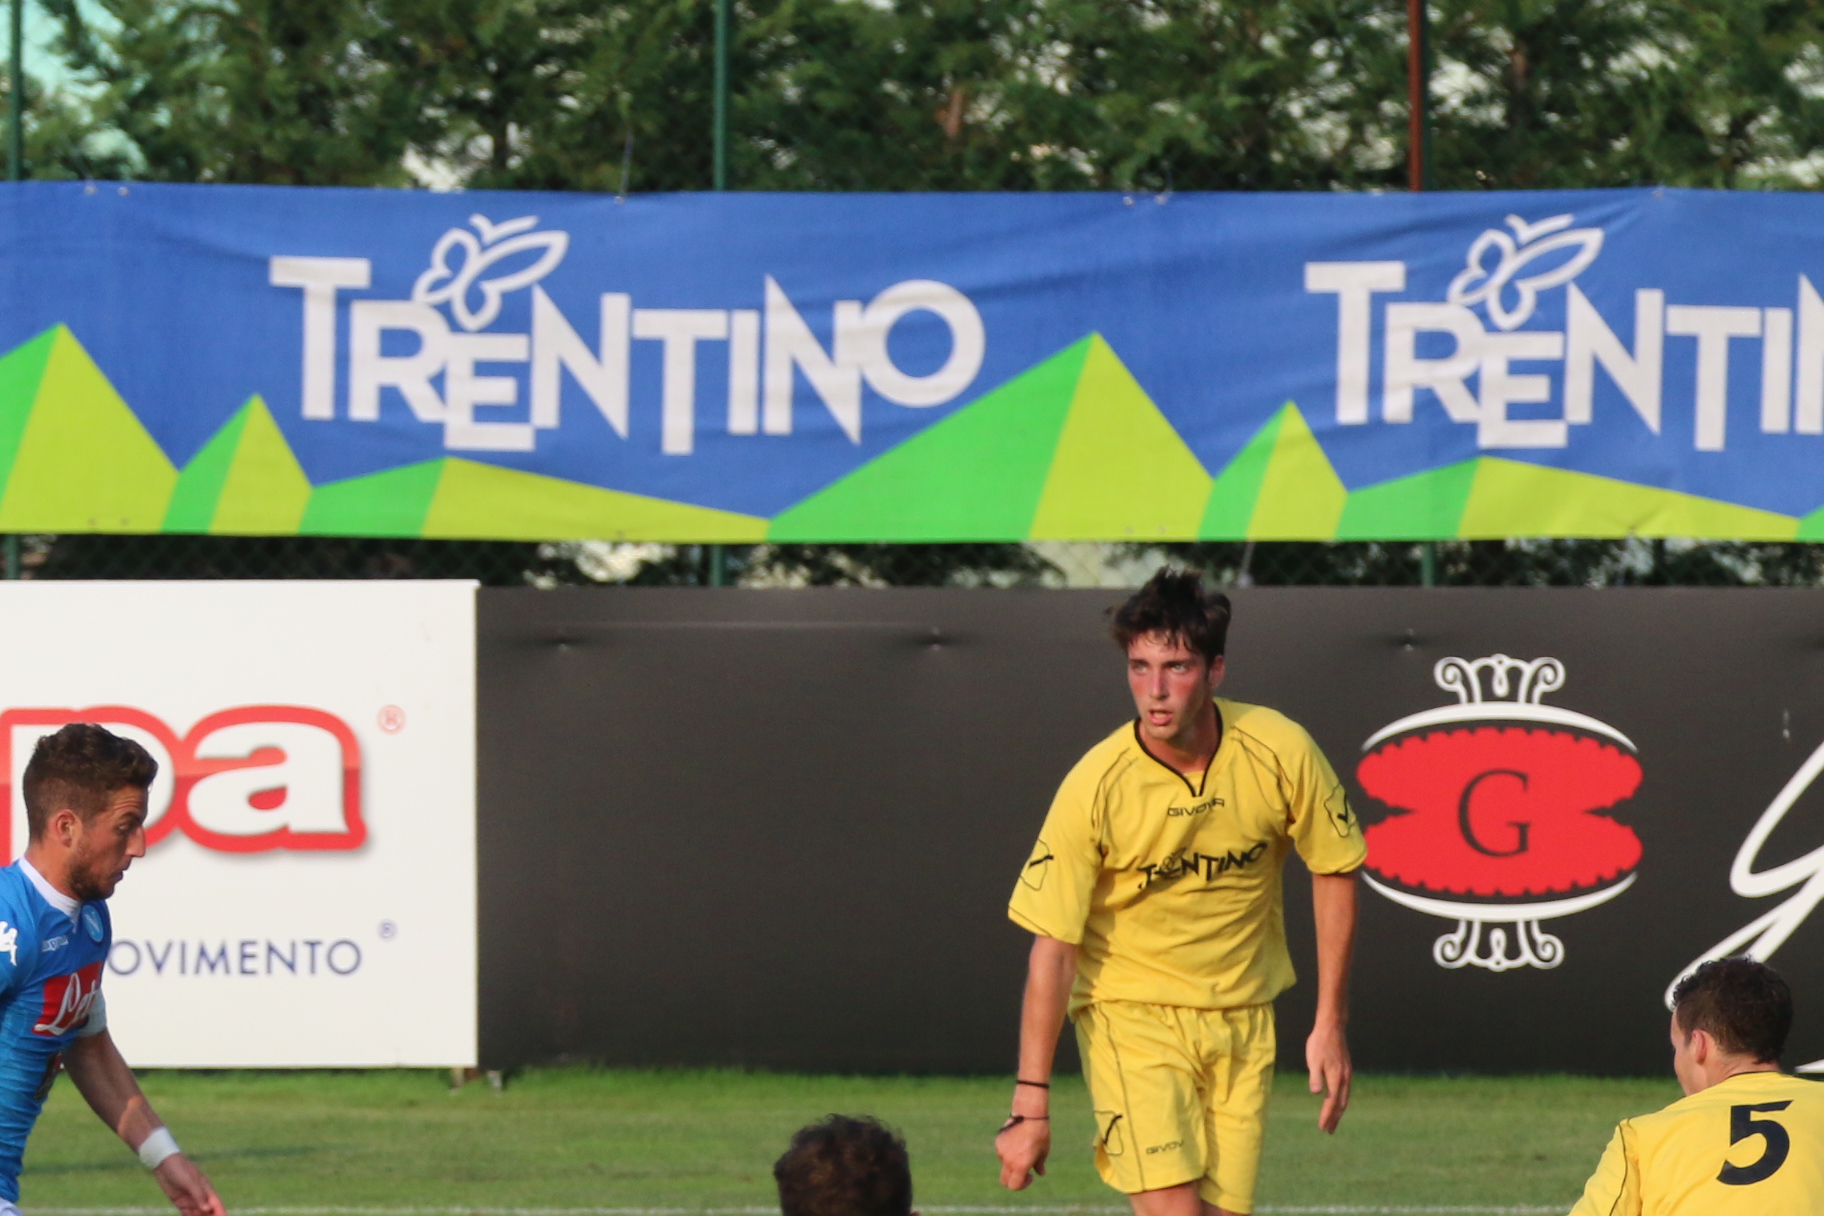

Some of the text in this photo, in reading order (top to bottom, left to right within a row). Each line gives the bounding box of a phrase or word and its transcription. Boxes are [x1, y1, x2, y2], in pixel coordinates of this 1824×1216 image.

[269, 255, 986, 454] TRENTINO
[1457, 768, 1531, 858] G
[108, 939, 362, 976] OVIMENTO
[1716, 1100, 1795, 1186] 5
